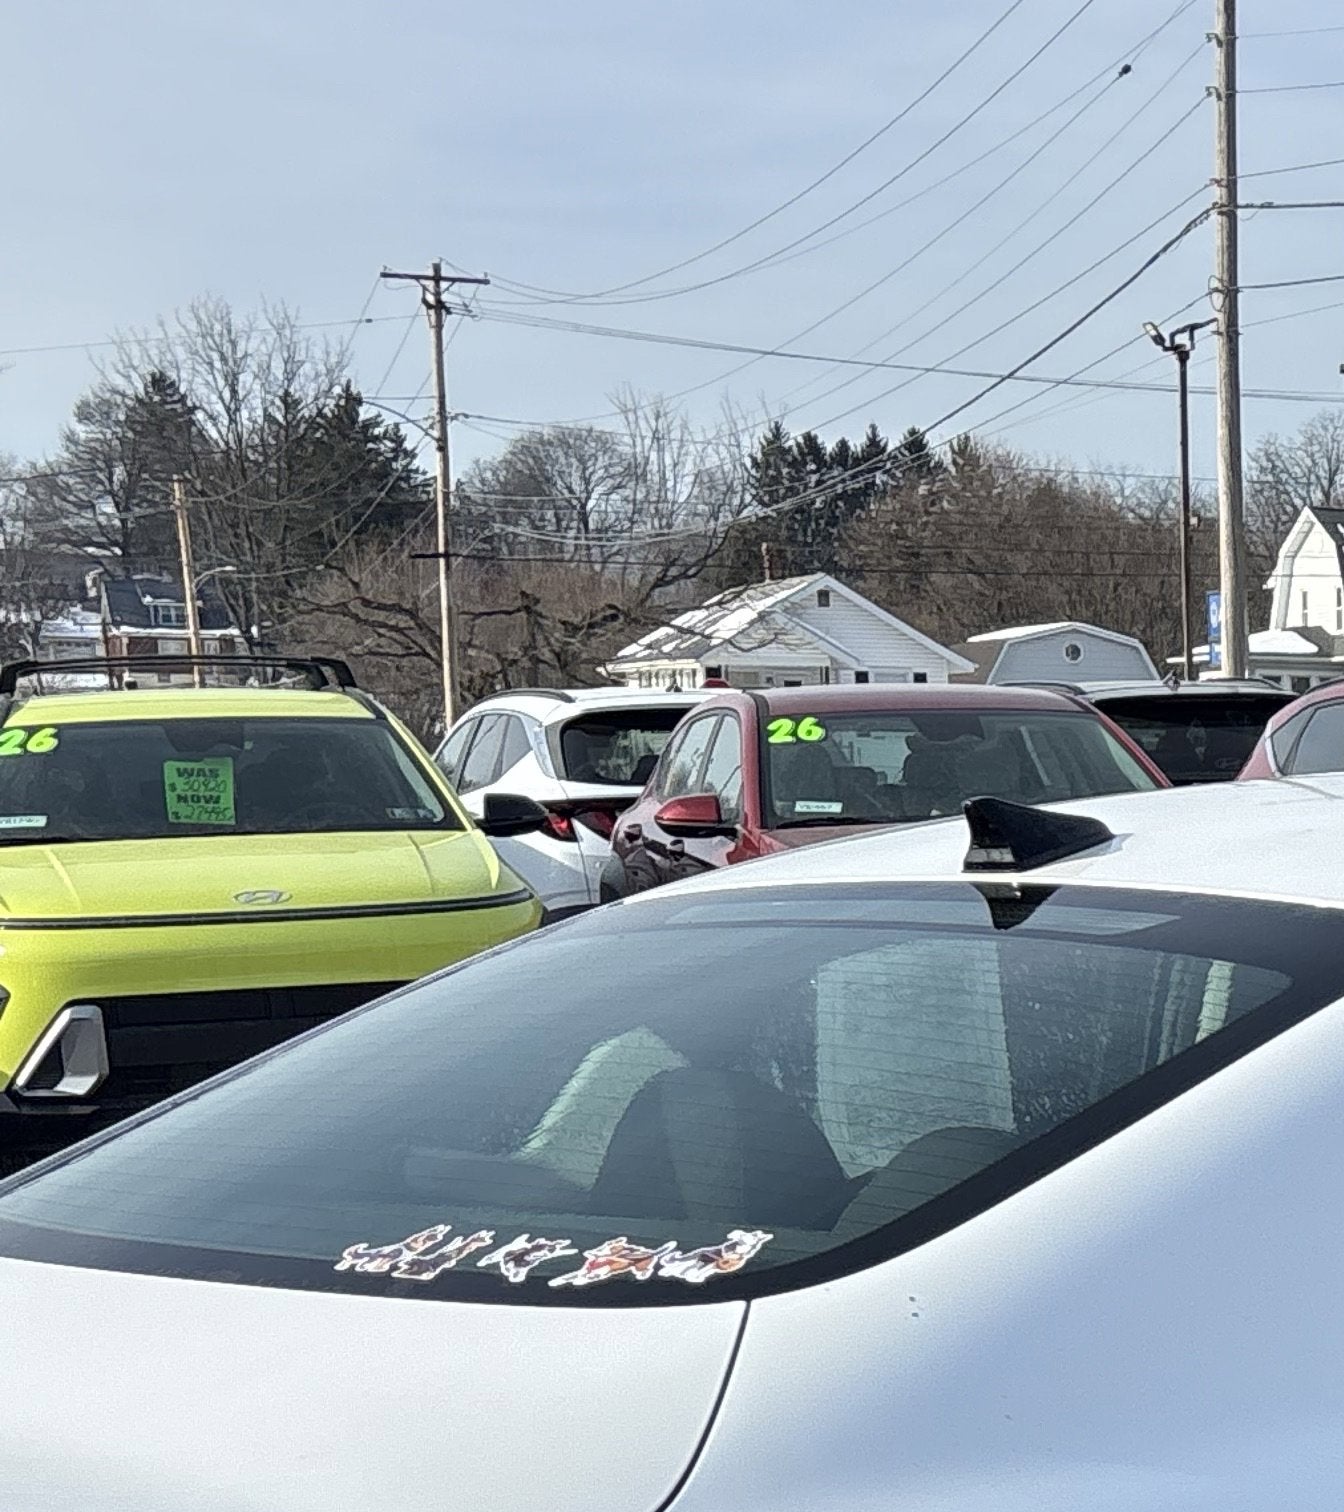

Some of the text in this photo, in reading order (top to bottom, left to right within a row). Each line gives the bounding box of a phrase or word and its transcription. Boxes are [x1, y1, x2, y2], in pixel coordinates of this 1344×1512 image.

[766, 716, 826, 743] 26
[0, 727, 59, 755] 26
[176, 767, 220, 779] WAS
[176, 793, 222, 804] NOW
